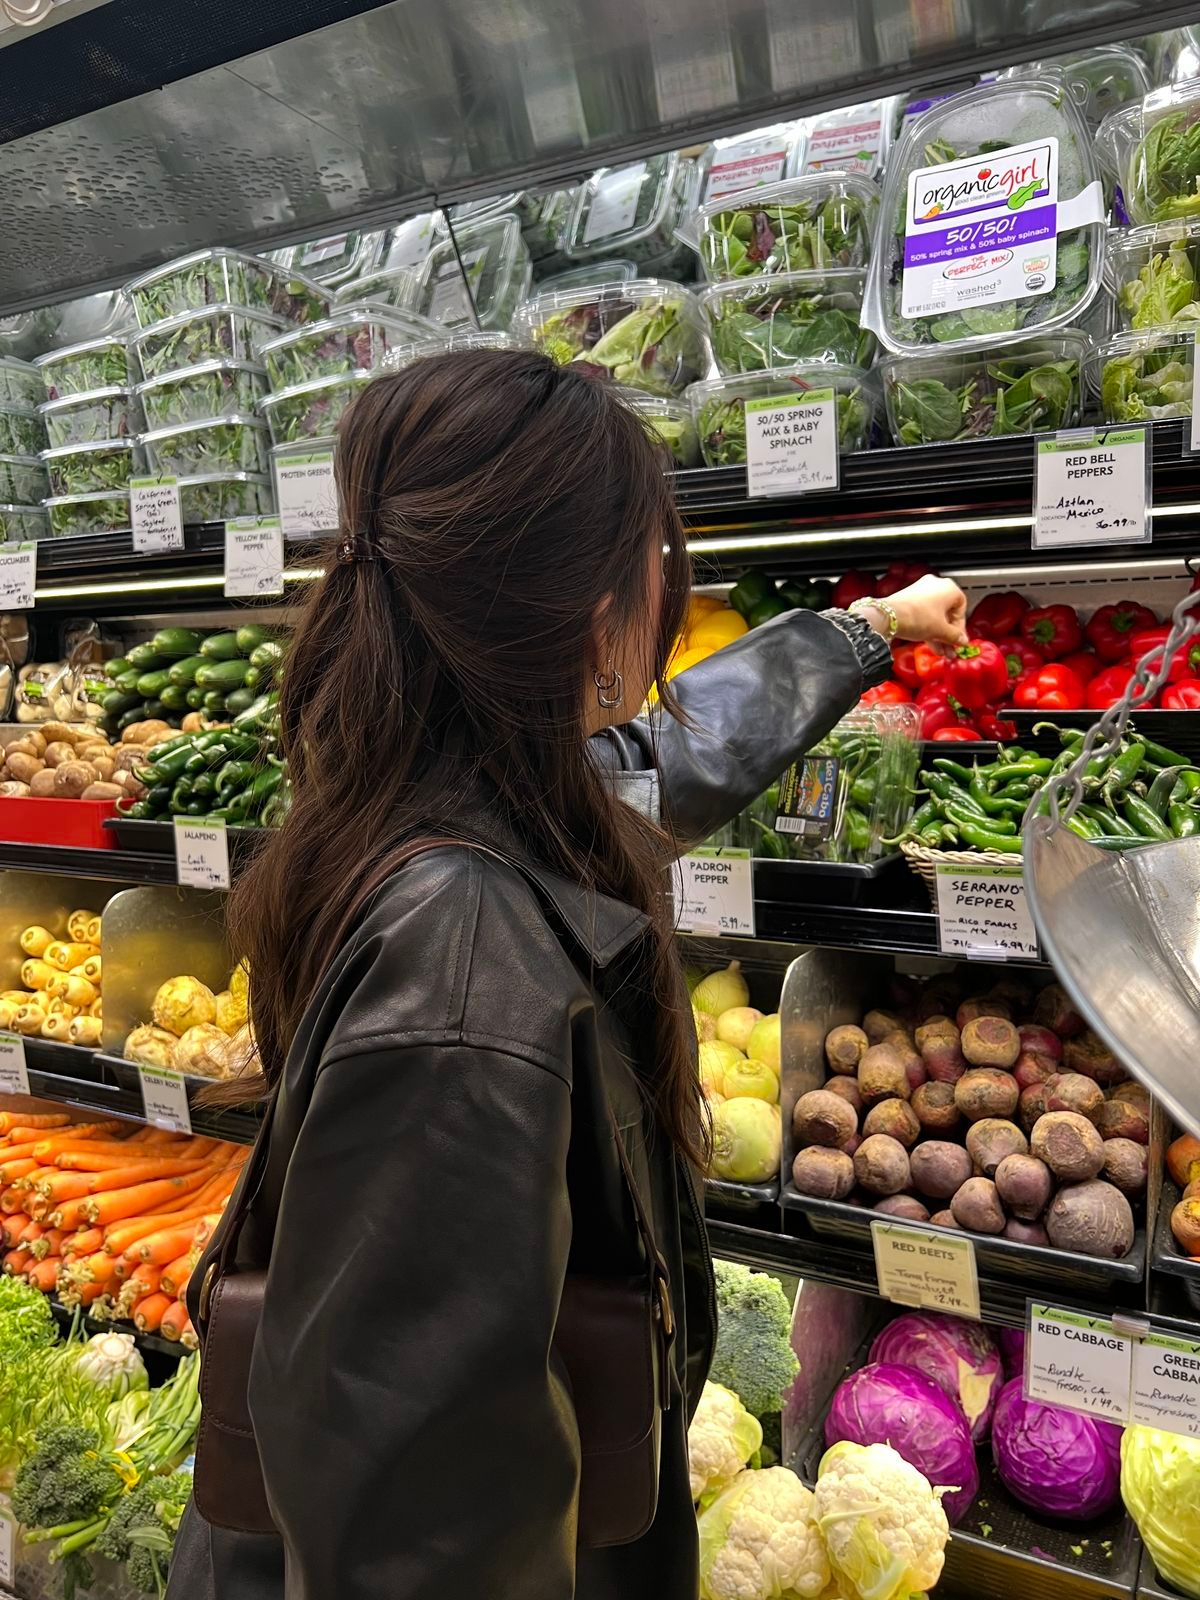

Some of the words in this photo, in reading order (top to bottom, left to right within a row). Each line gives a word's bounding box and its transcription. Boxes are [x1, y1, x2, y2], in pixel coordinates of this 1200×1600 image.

[922, 158, 1038, 210] organicgirl
[946, 216, 1018, 245] 50/50!
[910, 253, 928, 262] 50%
[929, 248, 953, 259] spring
[954, 244, 968, 253] mix
[979, 238, 996, 247] 50%
[997, 233, 1016, 244] baby
[1018, 226, 1050, 239] spinach
[948, 260, 987, 276] PERFECT
[991, 253, 1009, 265] MIX!
[757, 413, 785, 426] 50/50
[787, 407, 823, 421] SPRING
[762, 426, 781, 438] MIX
[783, 425, 790, 435] &
[793, 421, 820, 433] BABY
[770, 435, 813, 449] SPINACH
[1110, 434, 1136, 443] ORGANIC
[1065, 456, 1087, 467] RED
[1090, 453, 1116, 465] BELL
[307, 468, 331, 477] GREENS
[1067, 466, 1114, 479] PEPPERS
[1056, 495, 1094, 509] Aztlan
[1066, 507, 1104, 520] Mexico
[235, 534, 258, 543] YELLOW
[260, 532, 273, 540] BELL
[243, 543, 265, 552] PEPPER
[690, 862, 732, 872] PADRON
[694, 874, 729, 885] PEPPER
[952, 881, 1023, 895] SERRANO
[956, 894, 1016, 912] PEPPER
[958, 917, 979, 926] RICO
[984, 919, 1018, 931] FARMS
[970, 927, 988, 936] MX
[144, 1075, 164, 1086] CELERY
[892, 1240, 916, 1253] RED
[919, 1246, 955, 1261] BEETS
[1038, 1322, 1061, 1336] RED
[1064, 1329, 1124, 1352] CABBAGE
[1056, 1379, 1087, 1394] Fresno,
[1090, 1386, 1110, 1395] CA
